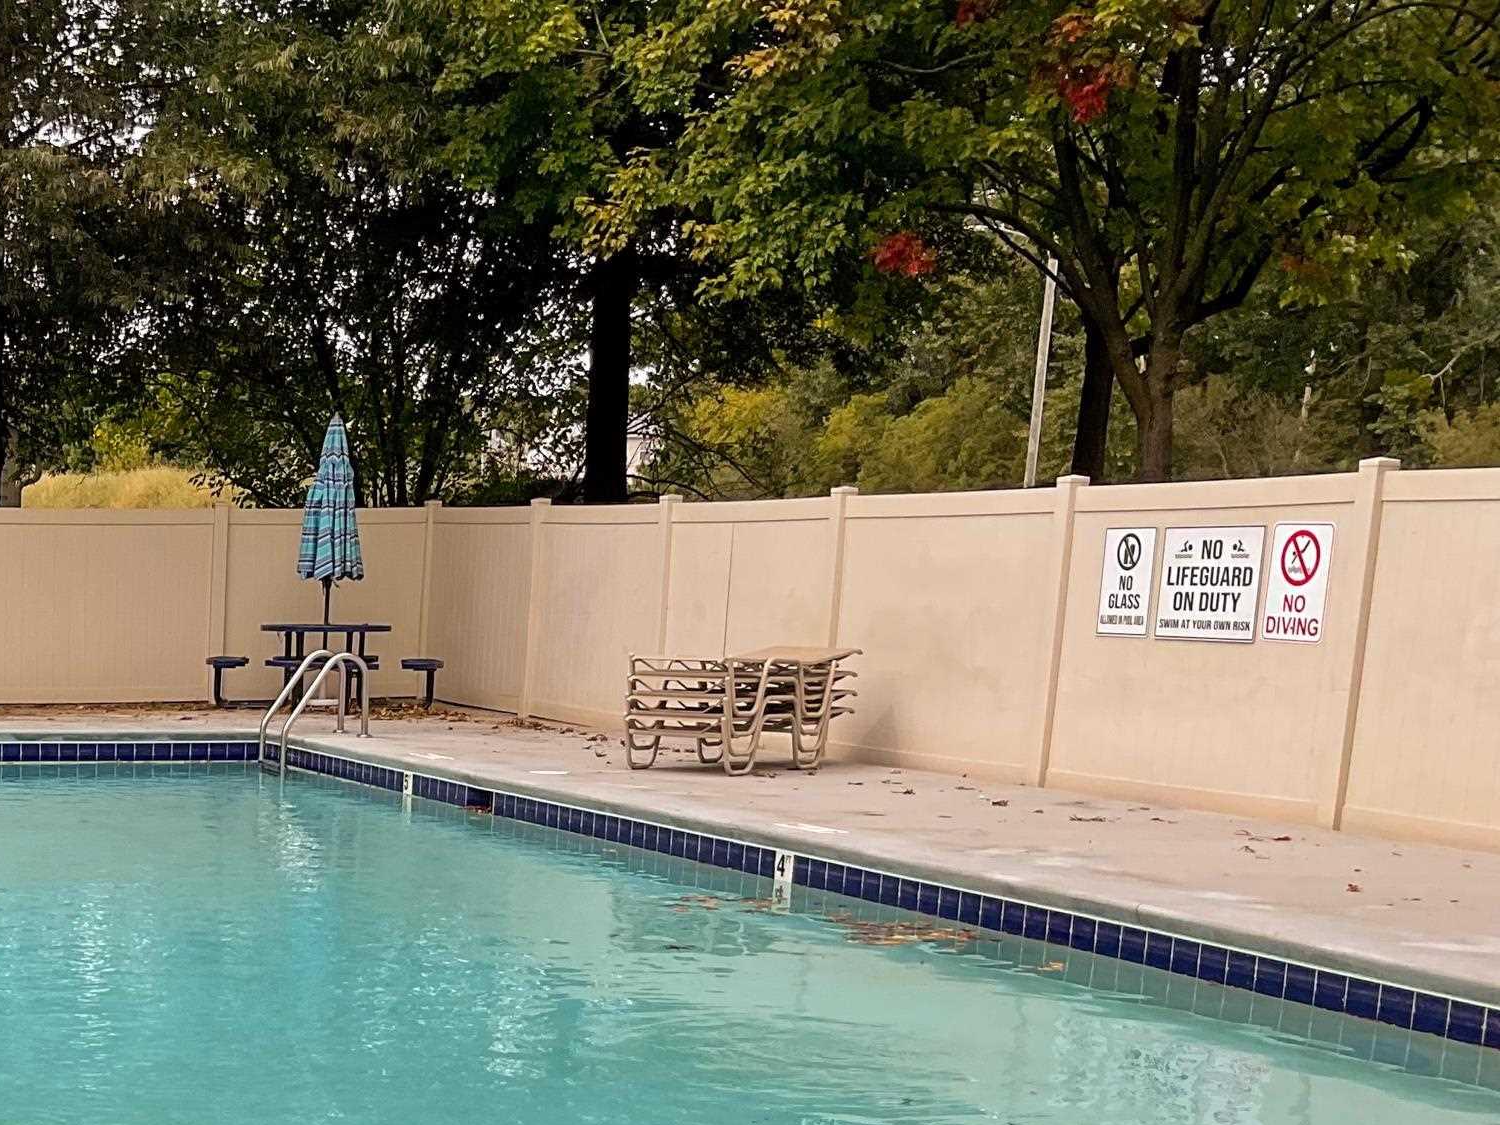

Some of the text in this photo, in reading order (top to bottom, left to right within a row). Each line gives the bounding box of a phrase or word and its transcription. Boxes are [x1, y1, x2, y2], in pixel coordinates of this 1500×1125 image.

[1201, 539, 1223, 559] NO
[1119, 575, 1133, 591] NO
[1166, 566, 1254, 586] LIFEGUARD
[1108, 593, 1141, 609] GLASS
[1173, 591, 1241, 613] ON DUTY
[1282, 594, 1306, 613] NO
[1159, 619, 1251, 631] SWIM AT YOUR OWN RISK
[1265, 616, 1319, 637] DIVING
